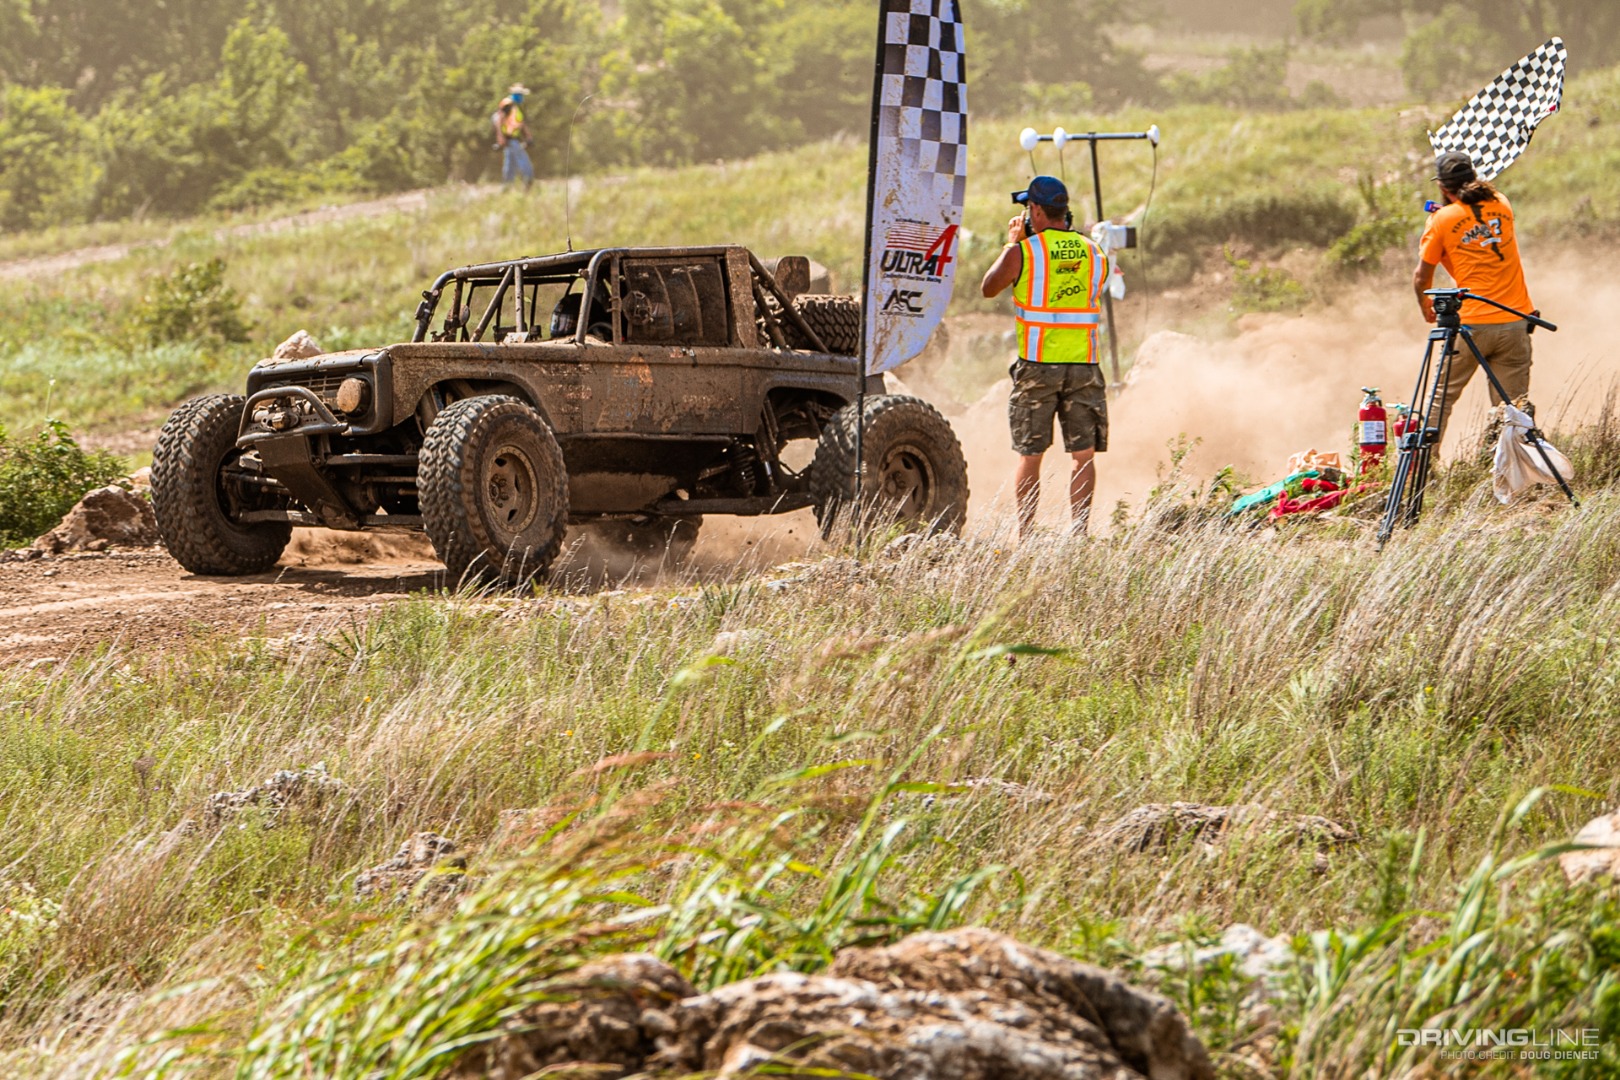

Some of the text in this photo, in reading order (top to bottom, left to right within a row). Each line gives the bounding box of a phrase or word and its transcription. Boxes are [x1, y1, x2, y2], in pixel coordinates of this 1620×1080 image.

[880, 224, 959, 277] ULTRA4
[1055, 239, 1082, 250] 1286
[1050, 249, 1089, 261] MEDIA
